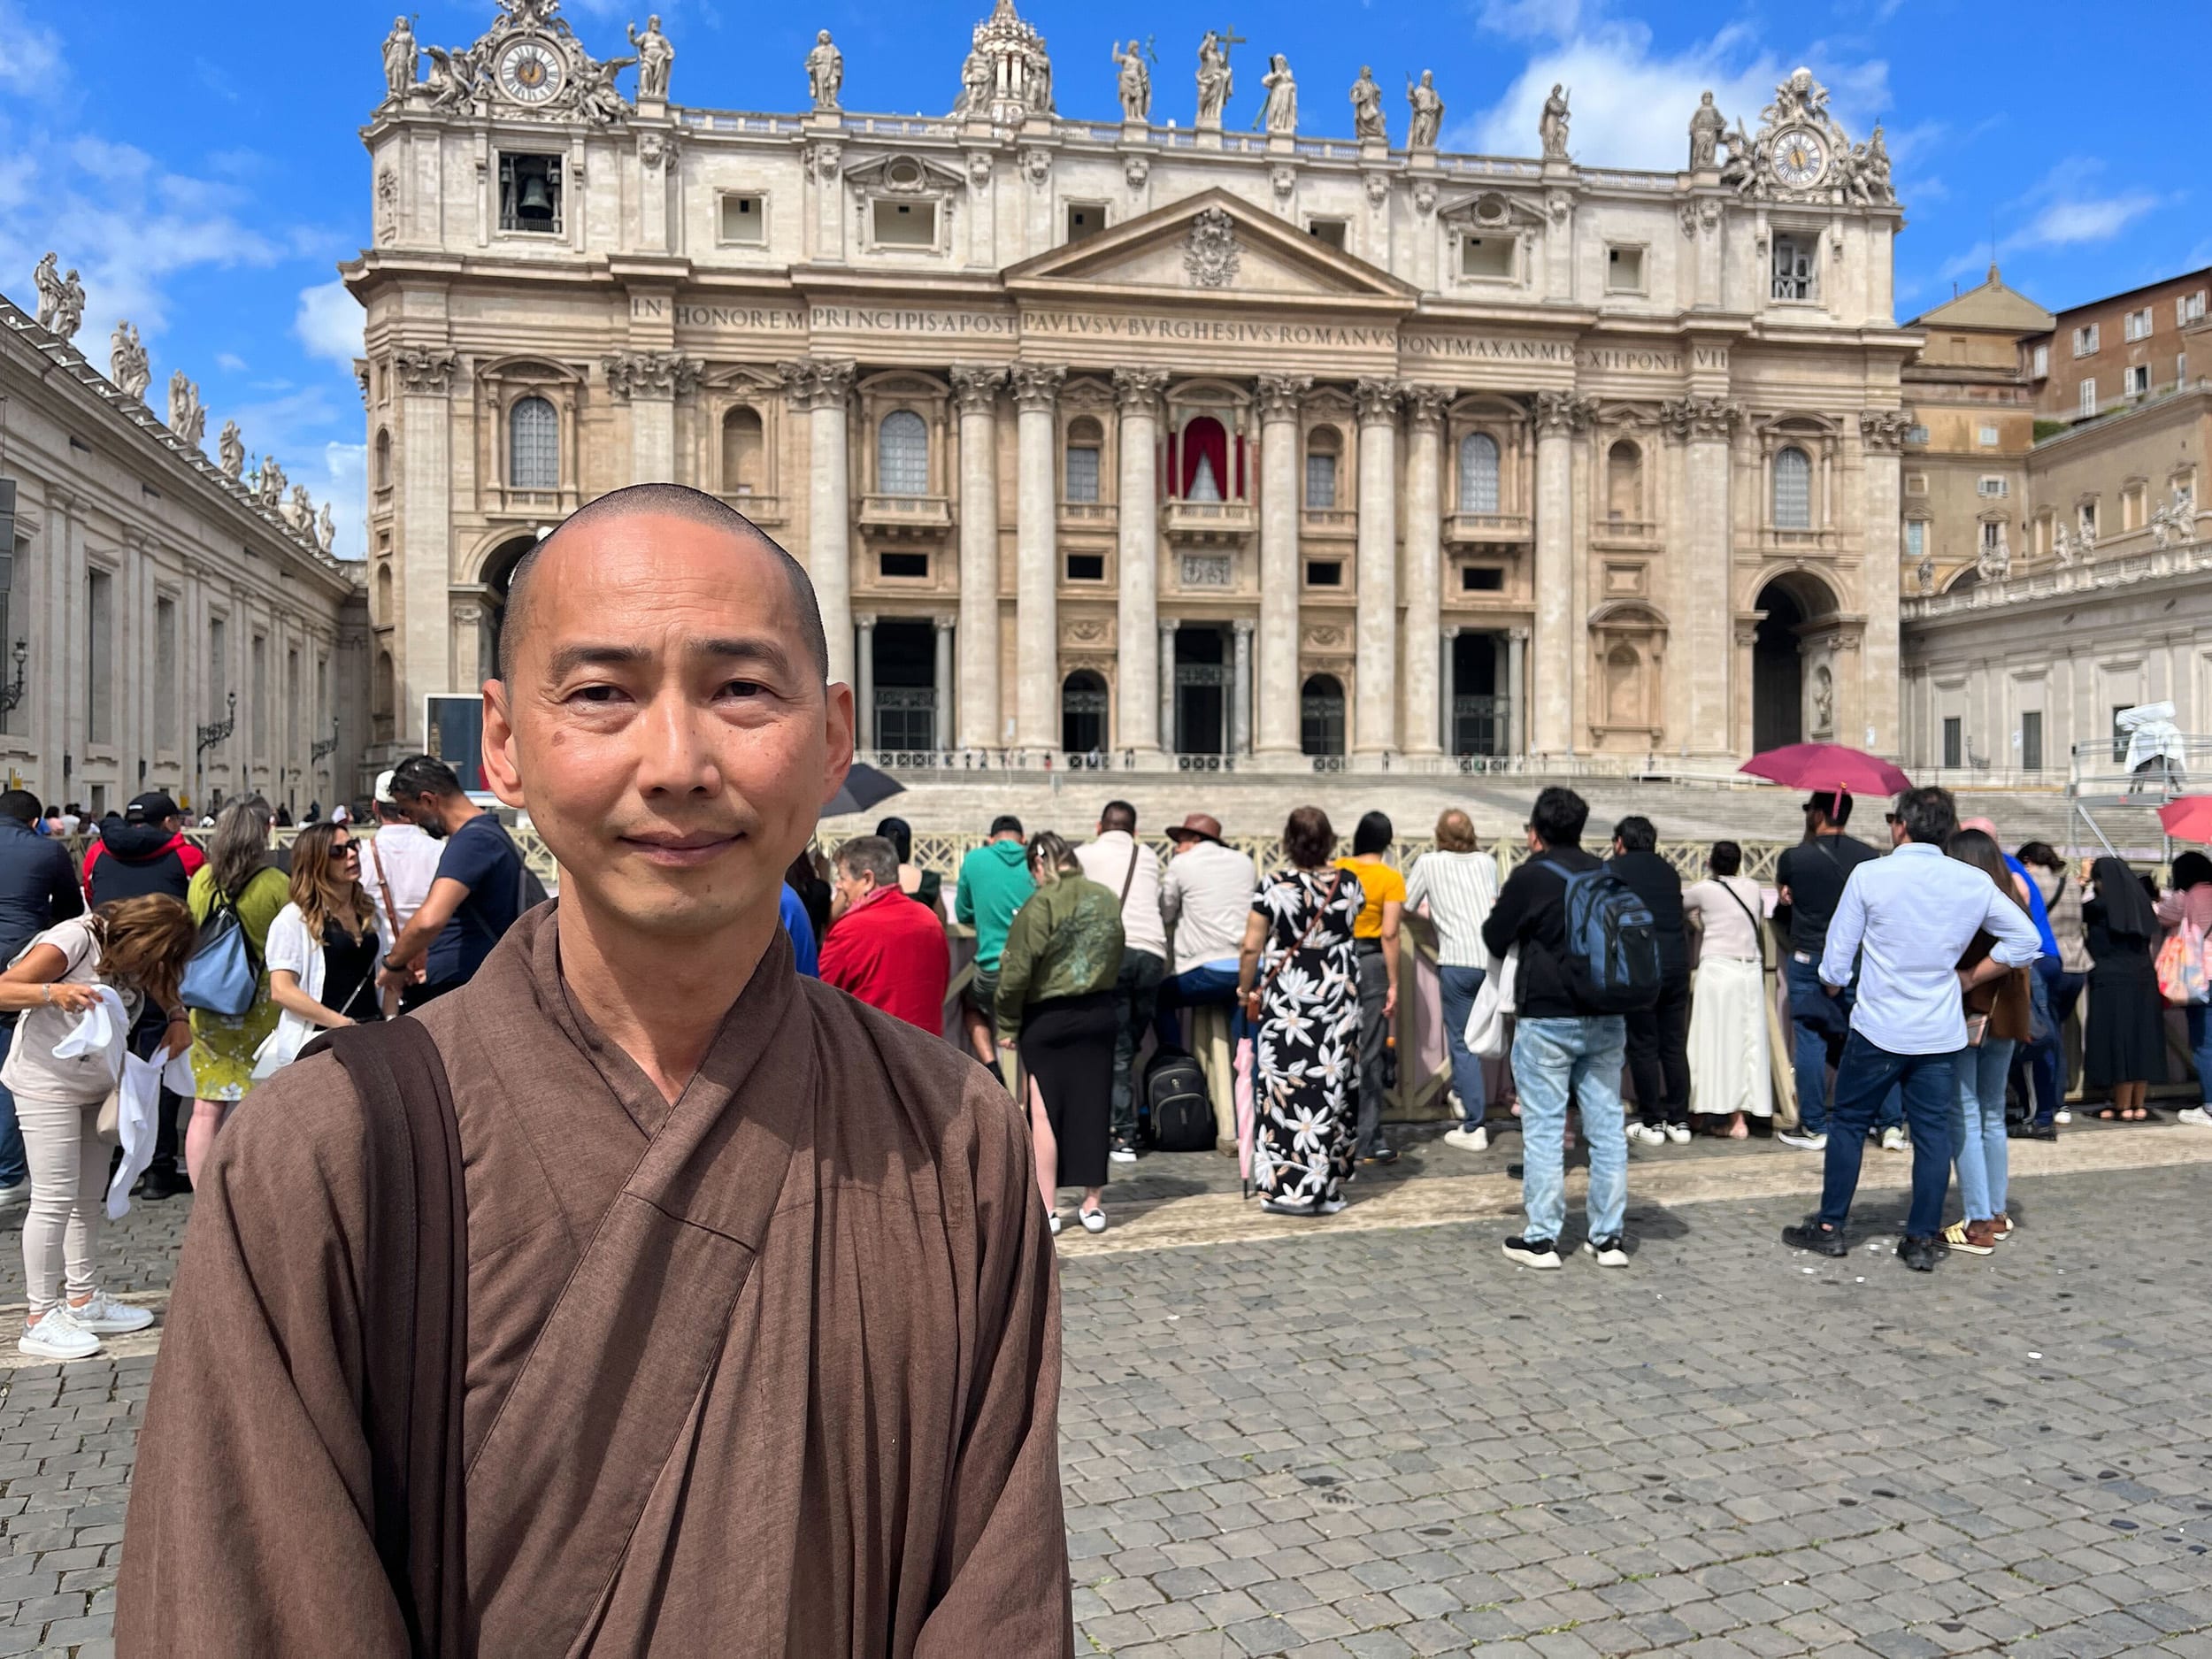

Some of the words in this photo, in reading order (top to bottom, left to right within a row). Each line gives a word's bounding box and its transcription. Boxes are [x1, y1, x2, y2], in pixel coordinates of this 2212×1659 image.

[633, 298, 662, 317] IN
[675, 306, 804, 330] HONOREM
[812, 309, 937, 330] PRINCIPIS
[941, 312, 1017, 334] APOST
[1024, 312, 1103, 334] PAVLVS
[1128, 319, 1273, 342] BVRGHESIVS
[1279, 325, 1396, 347] ROMANVS
[1397, 333, 1454, 355] PONT
[1696, 348, 1727, 368] VII
